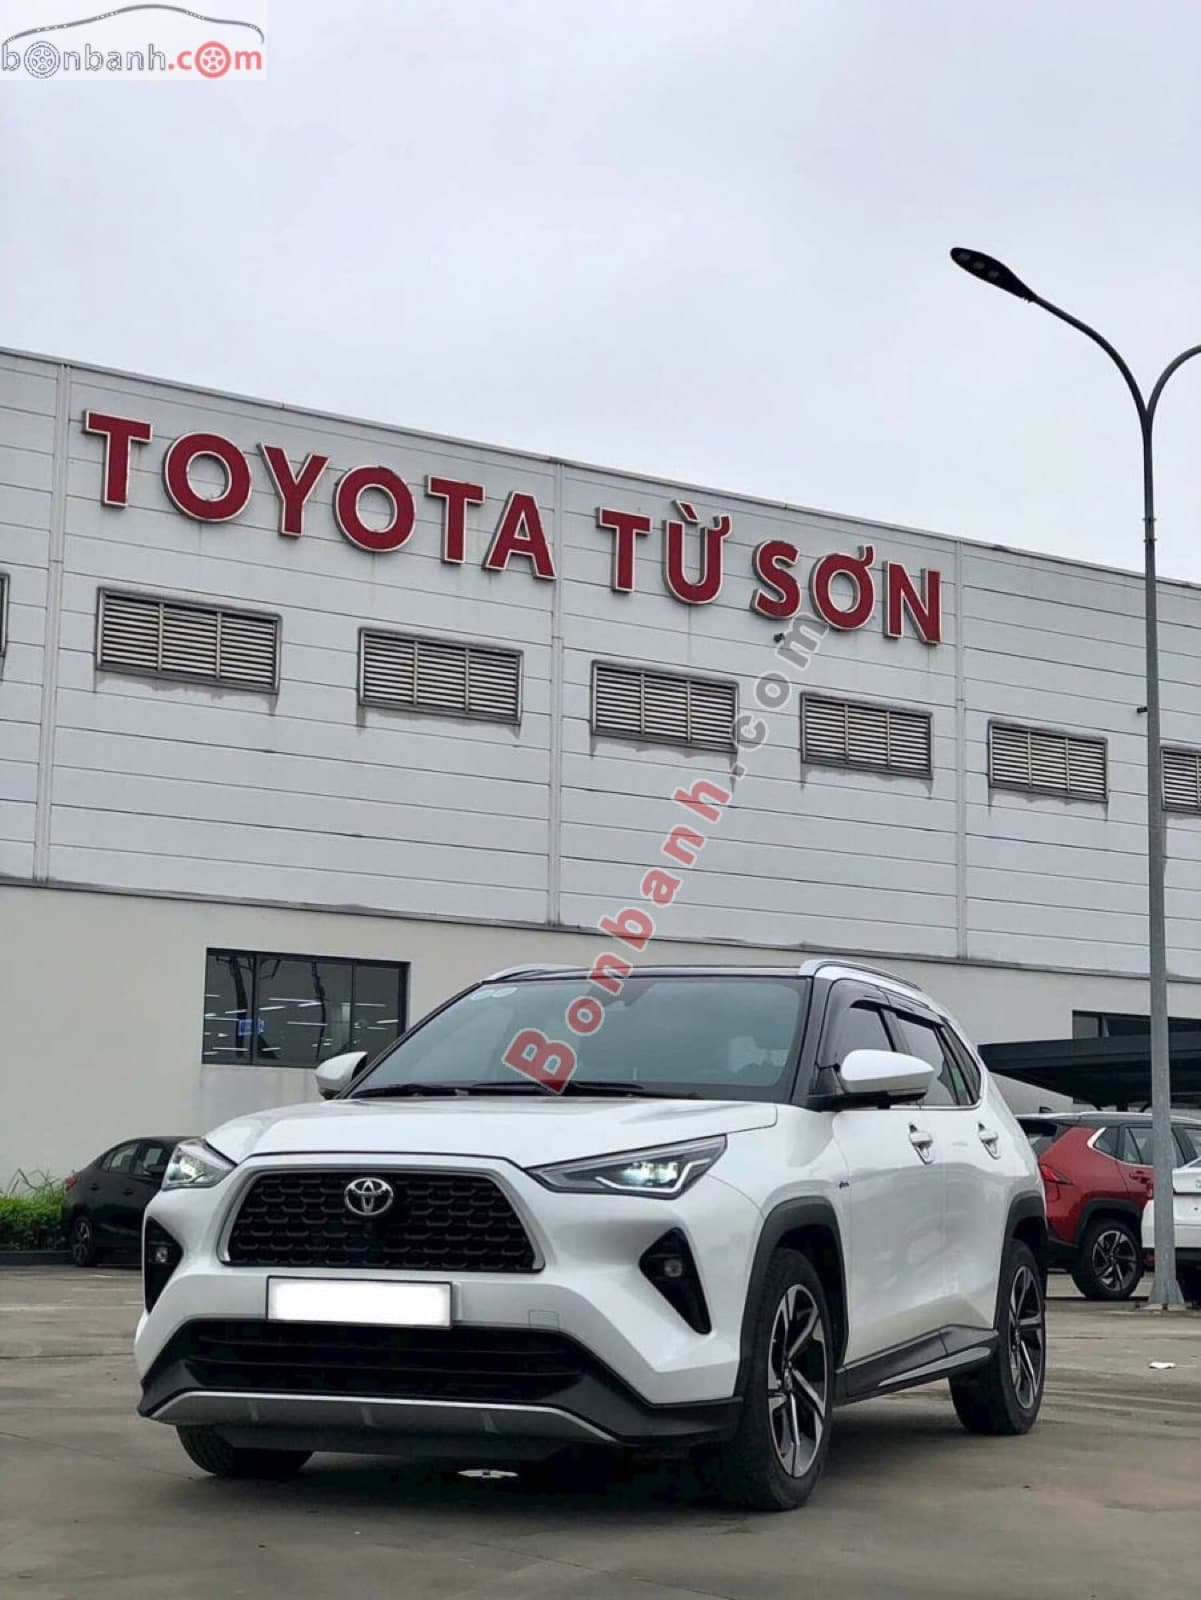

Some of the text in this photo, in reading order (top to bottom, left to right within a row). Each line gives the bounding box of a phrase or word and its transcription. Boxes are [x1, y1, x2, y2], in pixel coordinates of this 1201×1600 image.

[83, 409, 942, 645] TOYOTA TỪ SƠN
